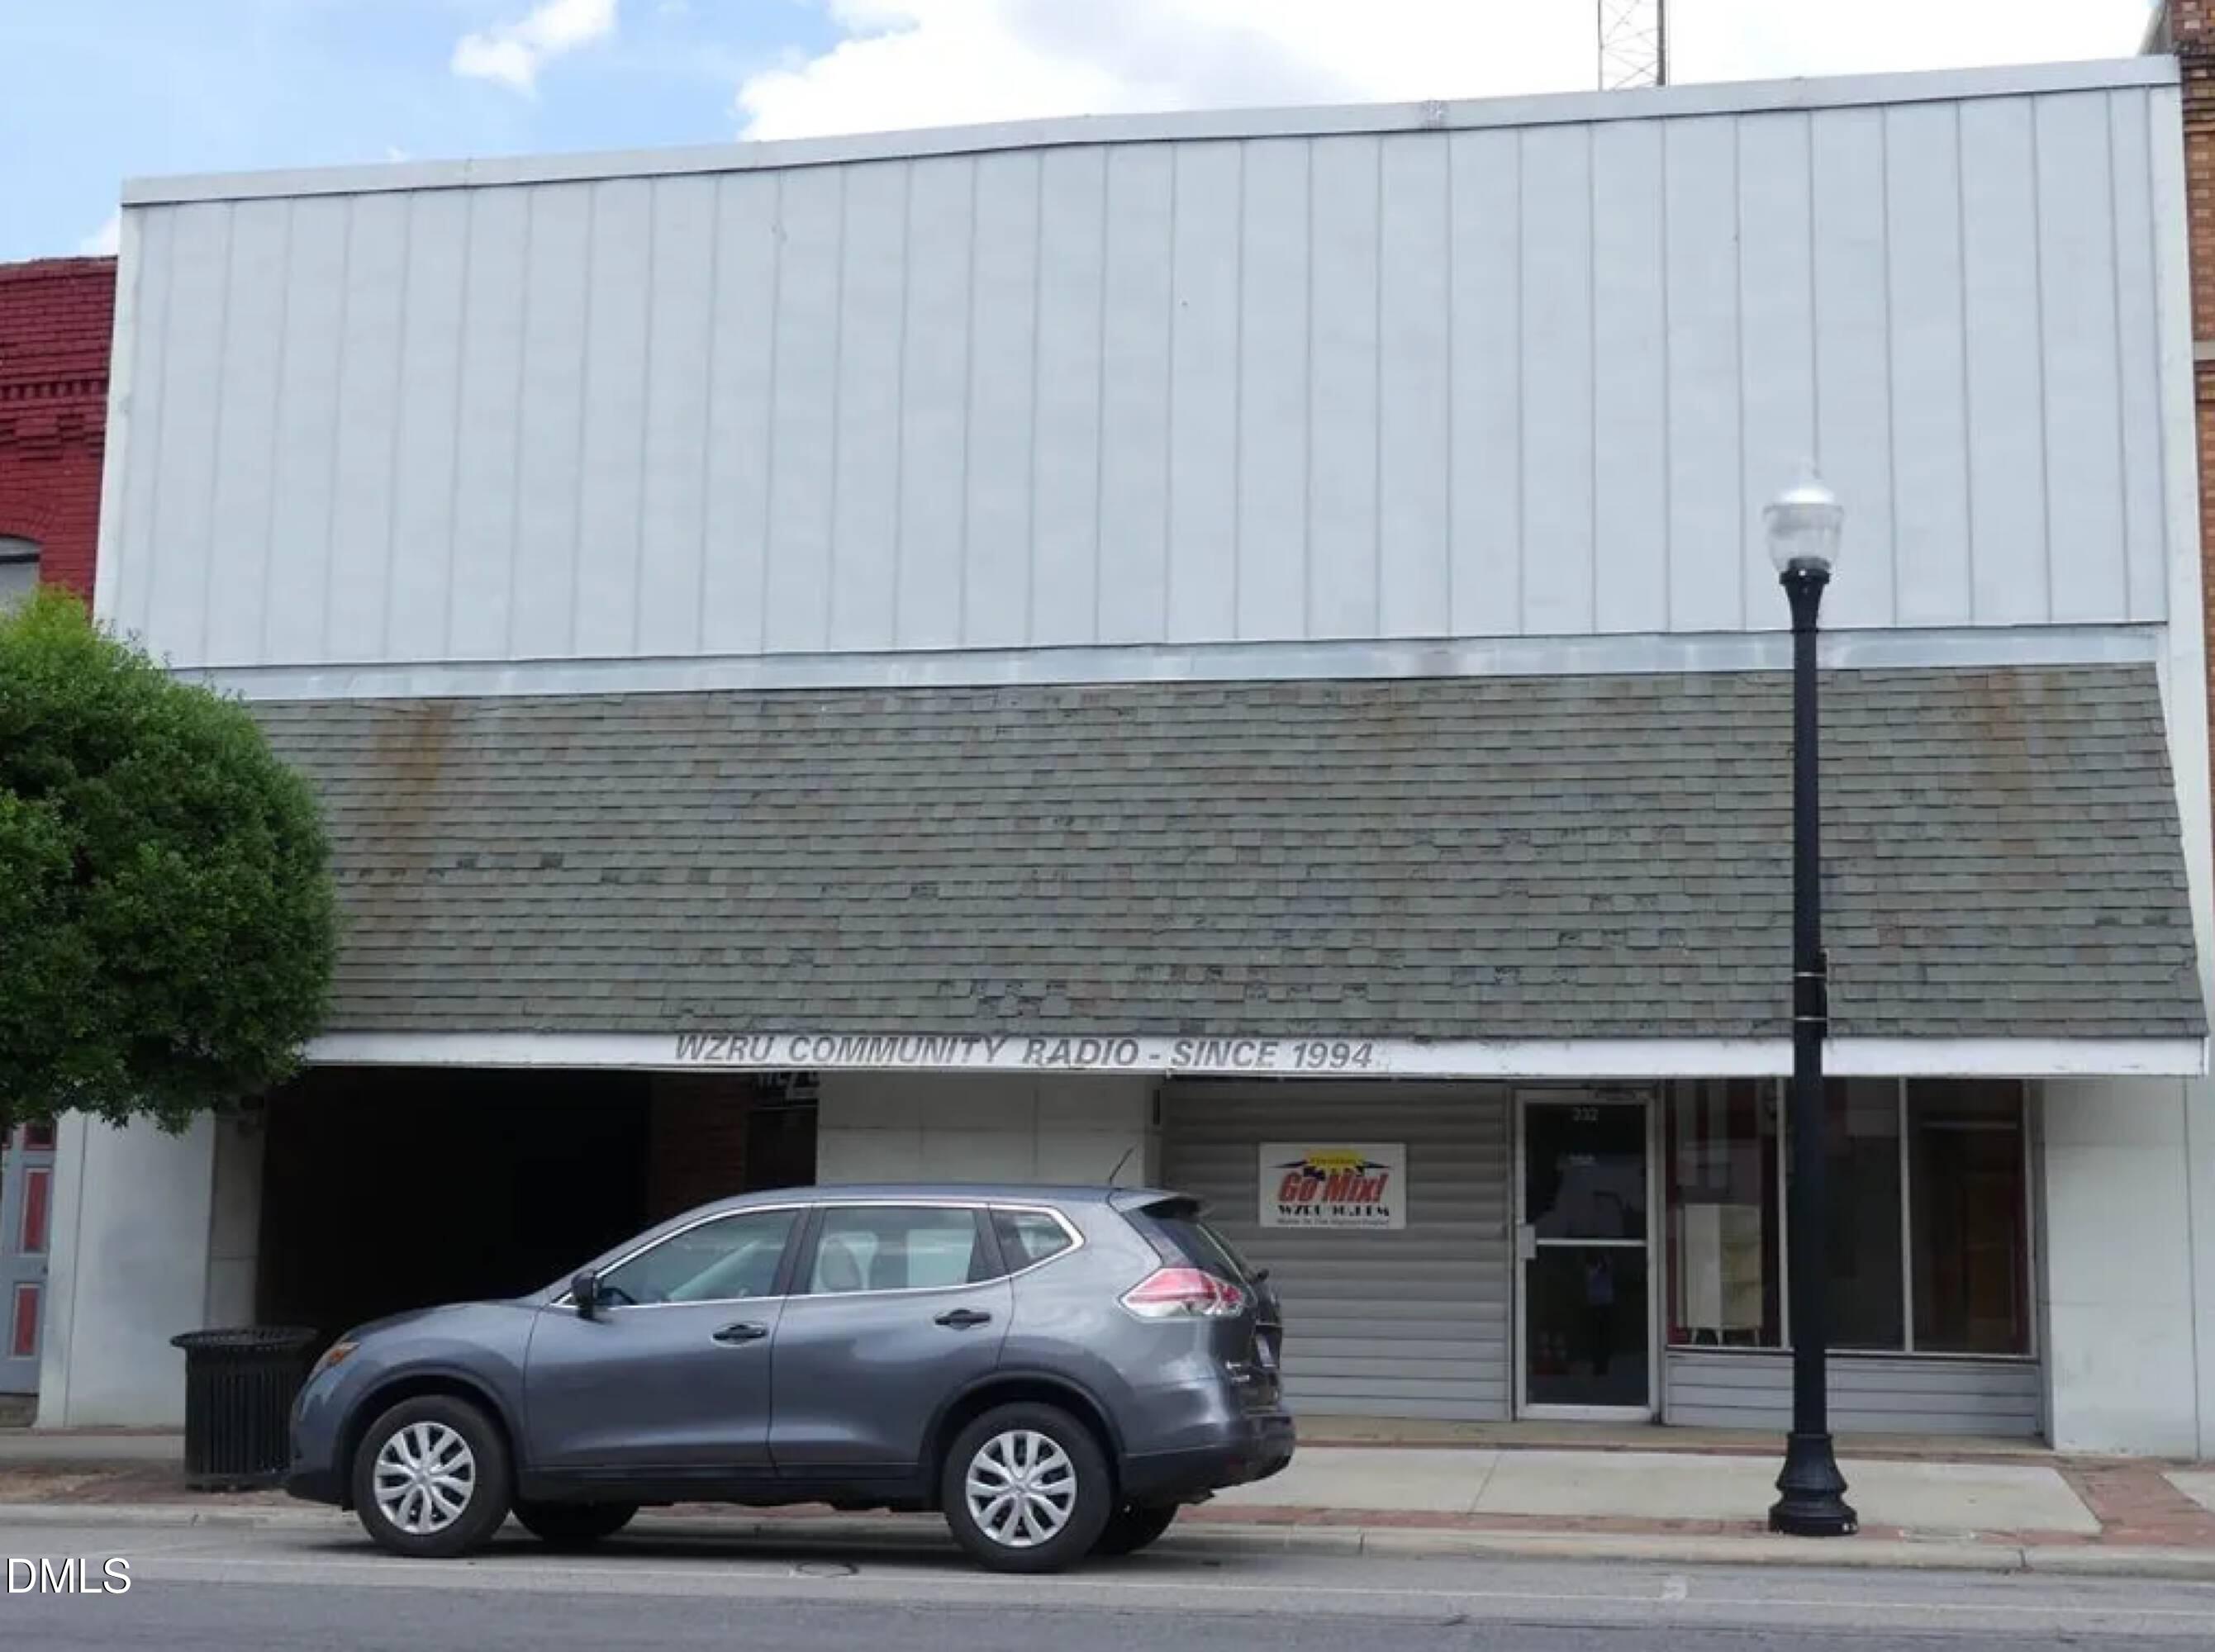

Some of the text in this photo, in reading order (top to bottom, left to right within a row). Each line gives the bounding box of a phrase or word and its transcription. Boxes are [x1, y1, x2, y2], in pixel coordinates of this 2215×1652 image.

[674, 1034, 775, 1062] WZRU
[788, 1037, 1006, 1065] COMMUNITY
[1022, 1038, 1140, 1066] RADIO
[1171, 1039, 1280, 1067] SINCE
[1292, 1042, 1373, 1069] 1994
[1277, 1171, 1319, 1203] Go
